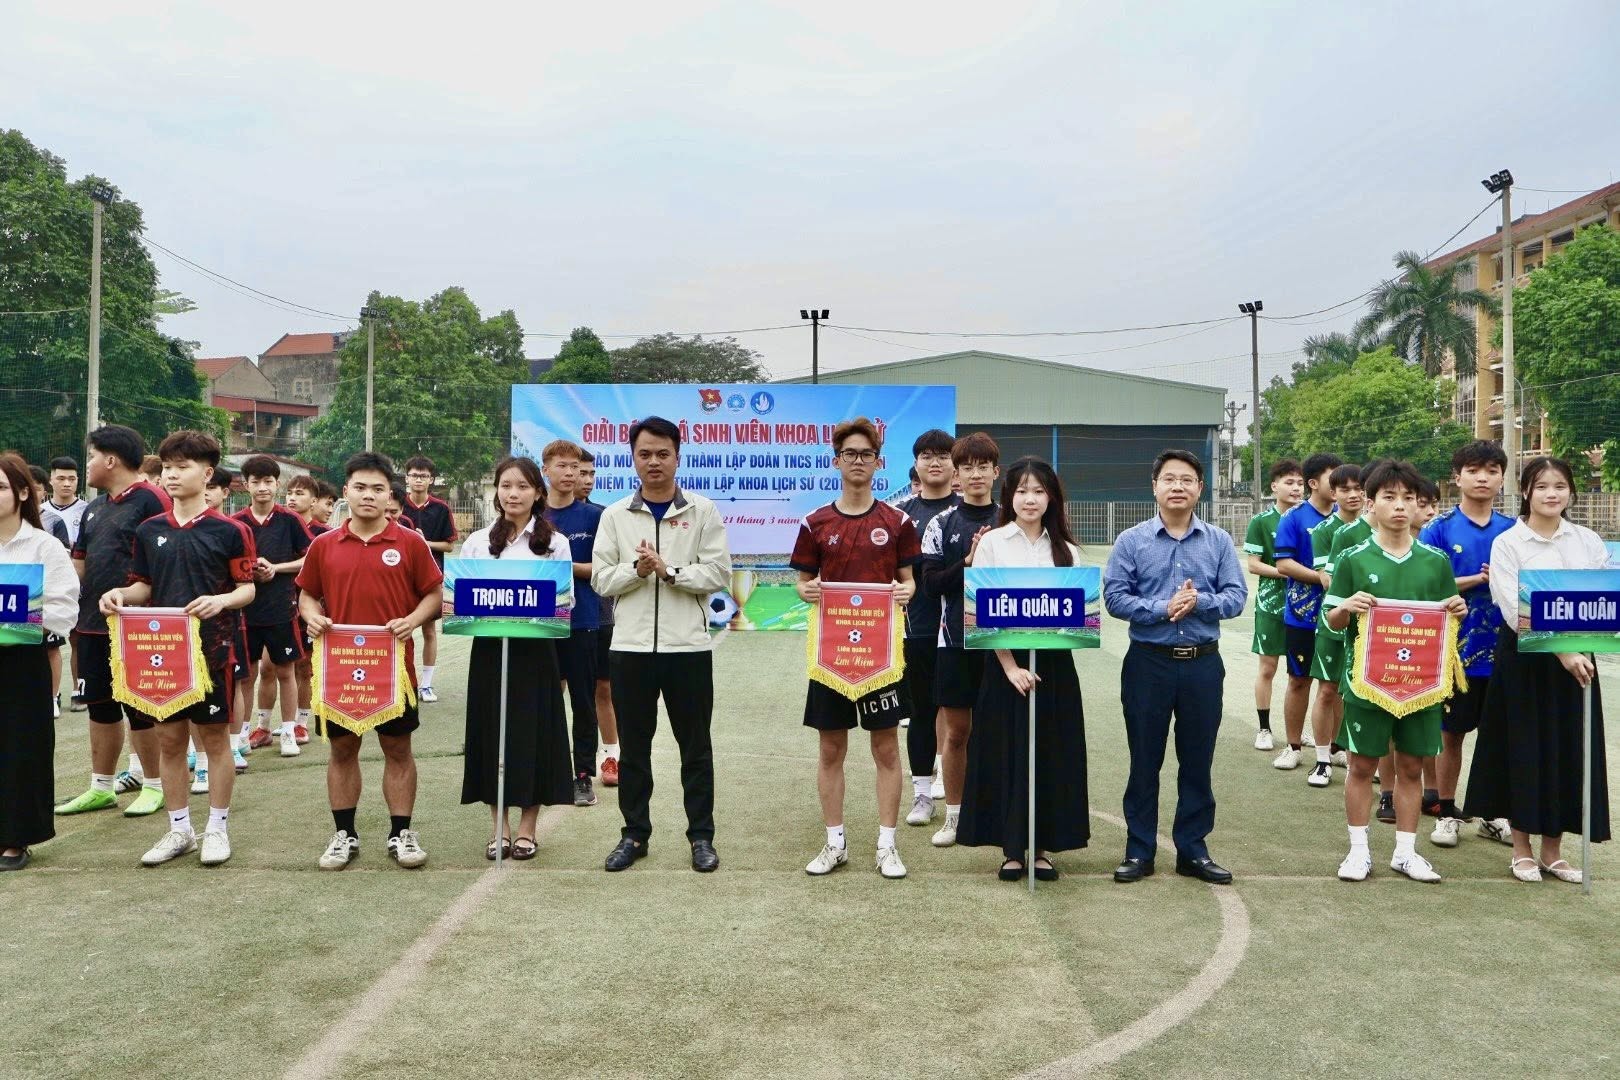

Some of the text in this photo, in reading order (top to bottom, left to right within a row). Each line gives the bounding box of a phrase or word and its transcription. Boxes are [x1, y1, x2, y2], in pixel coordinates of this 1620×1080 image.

[583, 417, 615, 444] GIẢI
[679, 419, 689, 444] Á
[692, 423, 731, 444] SINH
[735, 418, 771, 444] VIÊN
[776, 424, 819, 445] KHOA
[686, 452, 722, 468] THÀNH
[726, 452, 746, 470] LẬP
[750, 452, 780, 468] ĐOÀN
[784, 455, 812, 468] TNCS
[596, 472, 624, 492] NIỆM
[628, 477, 640, 490] 15
[714, 473, 734, 492] LẬP
[739, 476, 768, 490] KHOA
[772, 476, 796, 494] LỊCH
[800, 472, 816, 490] SỬ
[736, 515, 766, 526] tháng
[7, 594, 17, 612] 4
[472, 585, 538, 610] TRỌNG TÀI
[988, 593, 1072, 618] LIÊN QUÂN 3
[1544, 596, 1616, 621] LIÊN QUÂN
[863, 694, 899, 714] ICON
